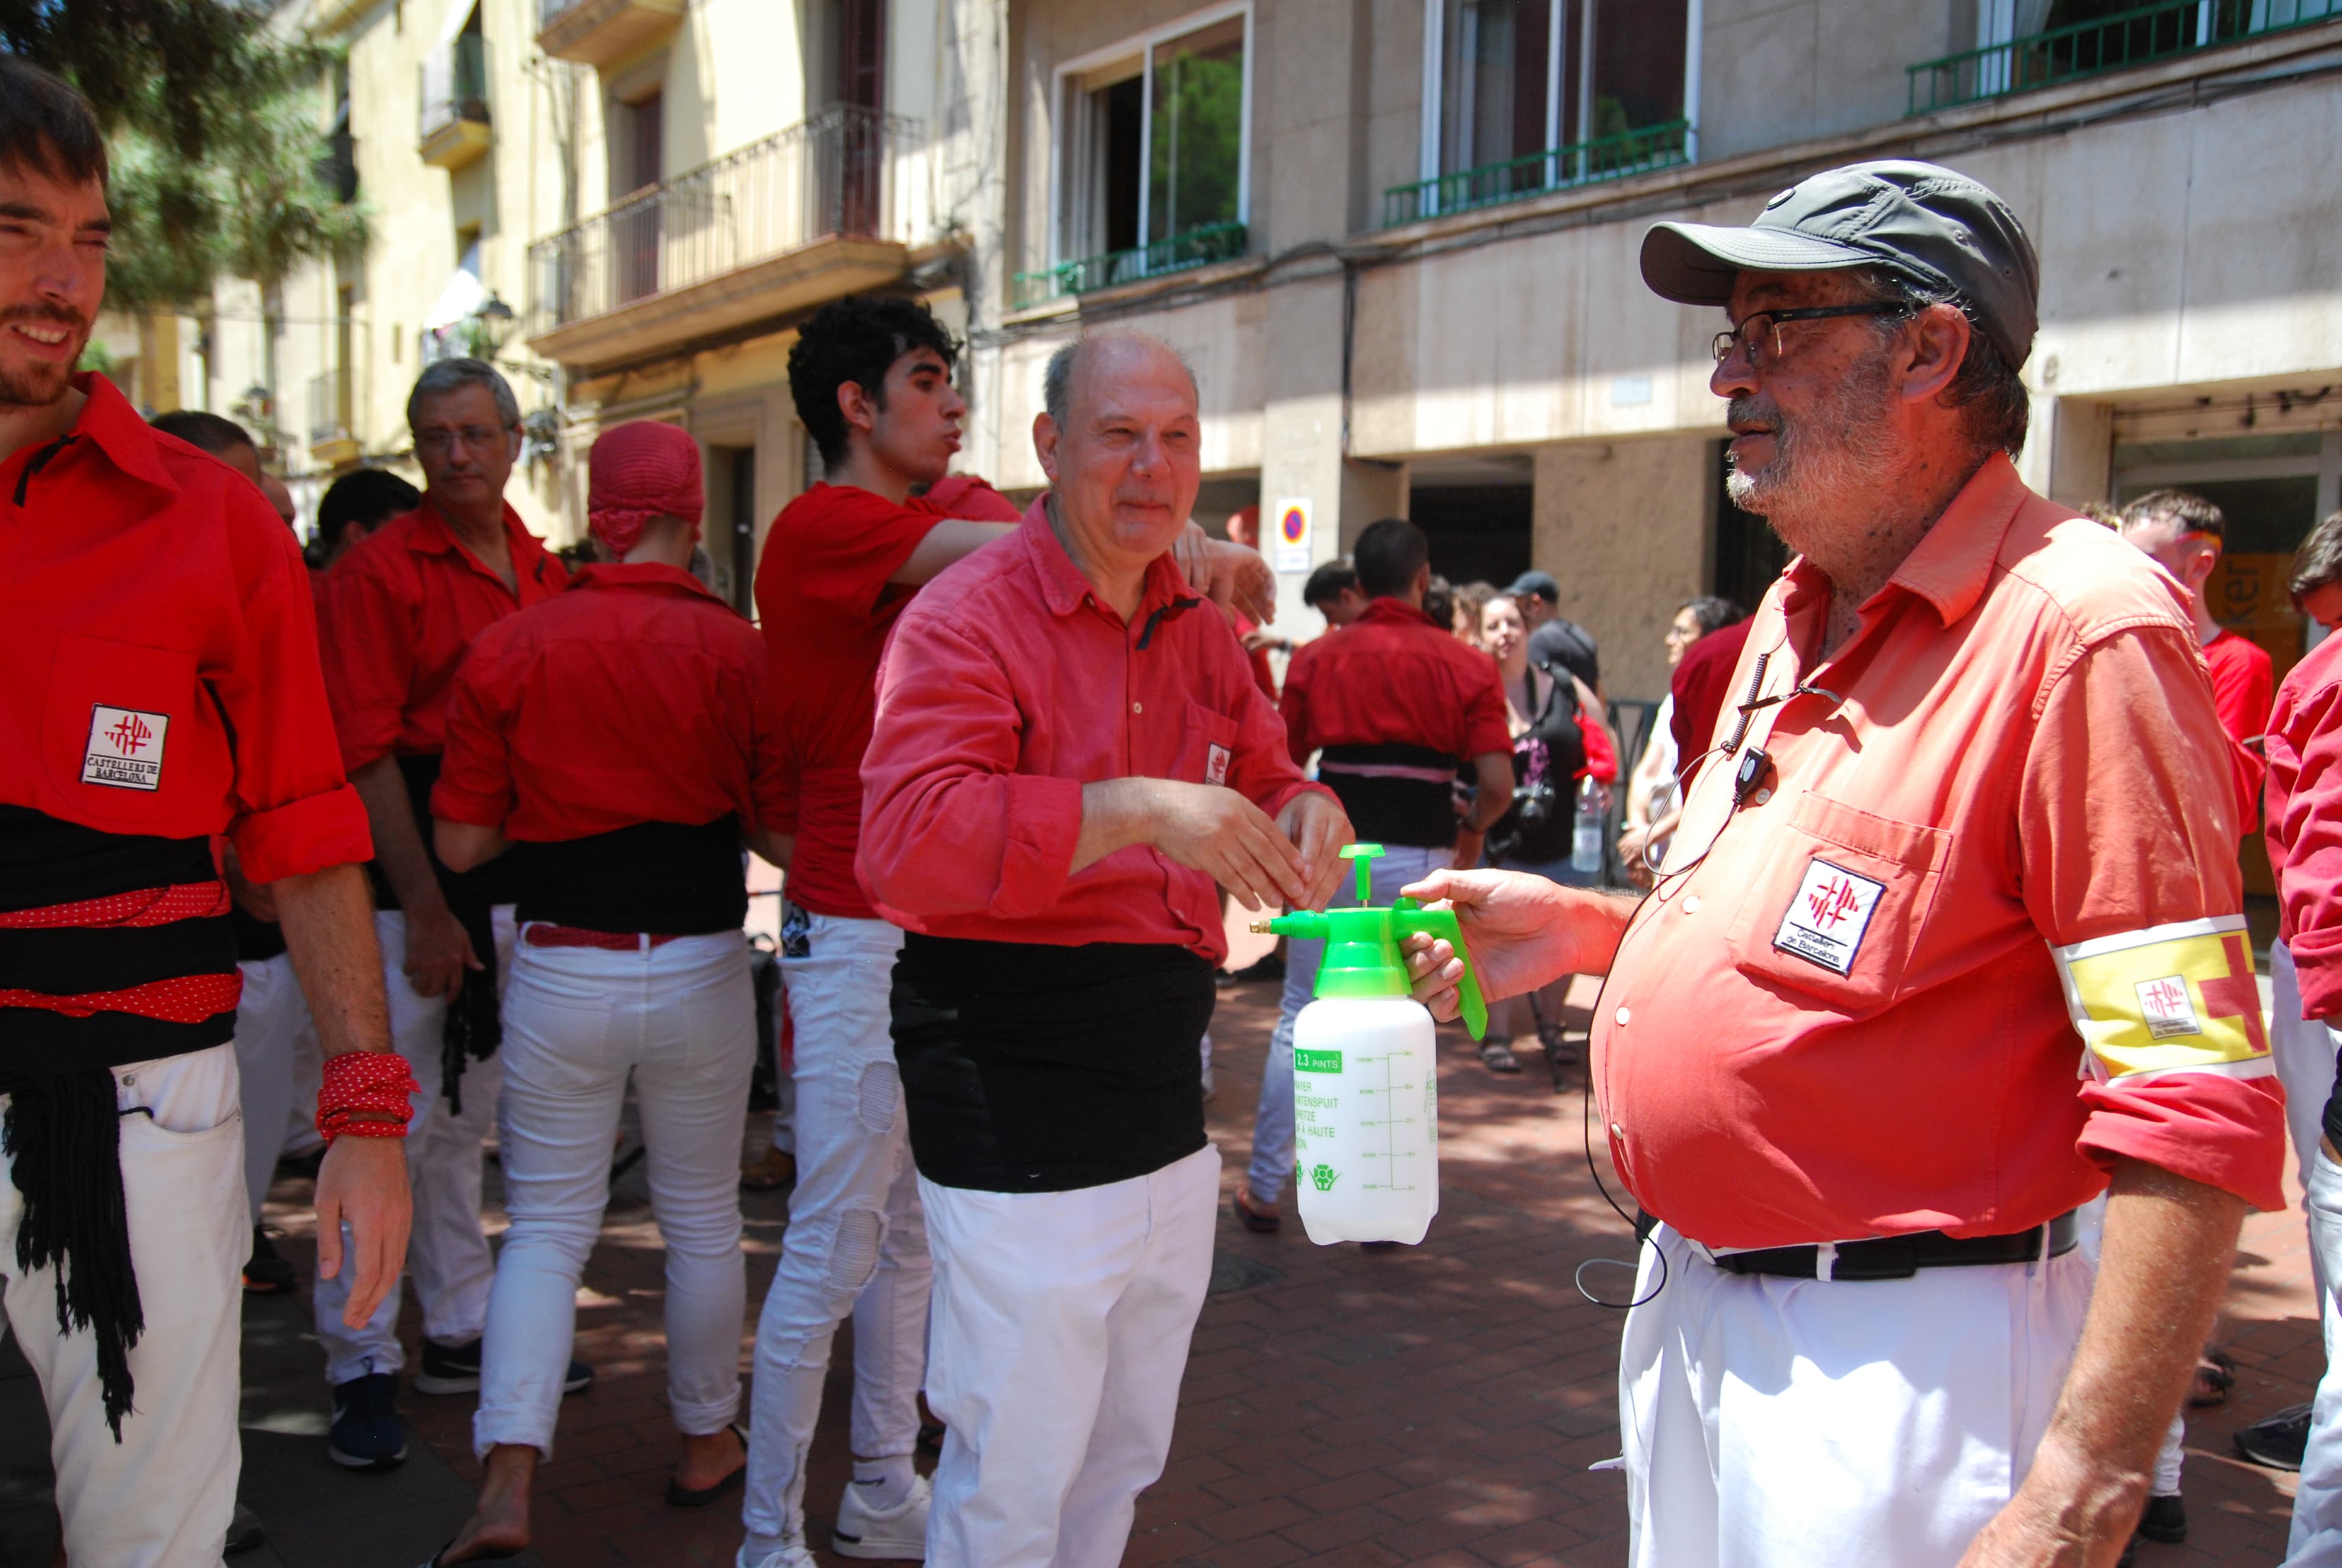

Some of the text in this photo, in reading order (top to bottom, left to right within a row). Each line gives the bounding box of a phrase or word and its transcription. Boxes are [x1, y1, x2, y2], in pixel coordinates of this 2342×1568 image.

[87, 757, 158, 775] CASTELLERS DE
[95, 767, 146, 783] BARCELONA
[1797, 928, 1836, 951] Castellers
[1798, 939, 1840, 964] Barcelona
[1297, 1053, 1339, 1069] 2.3 PINTS
[1308, 1126, 1336, 1137] HAUTE
